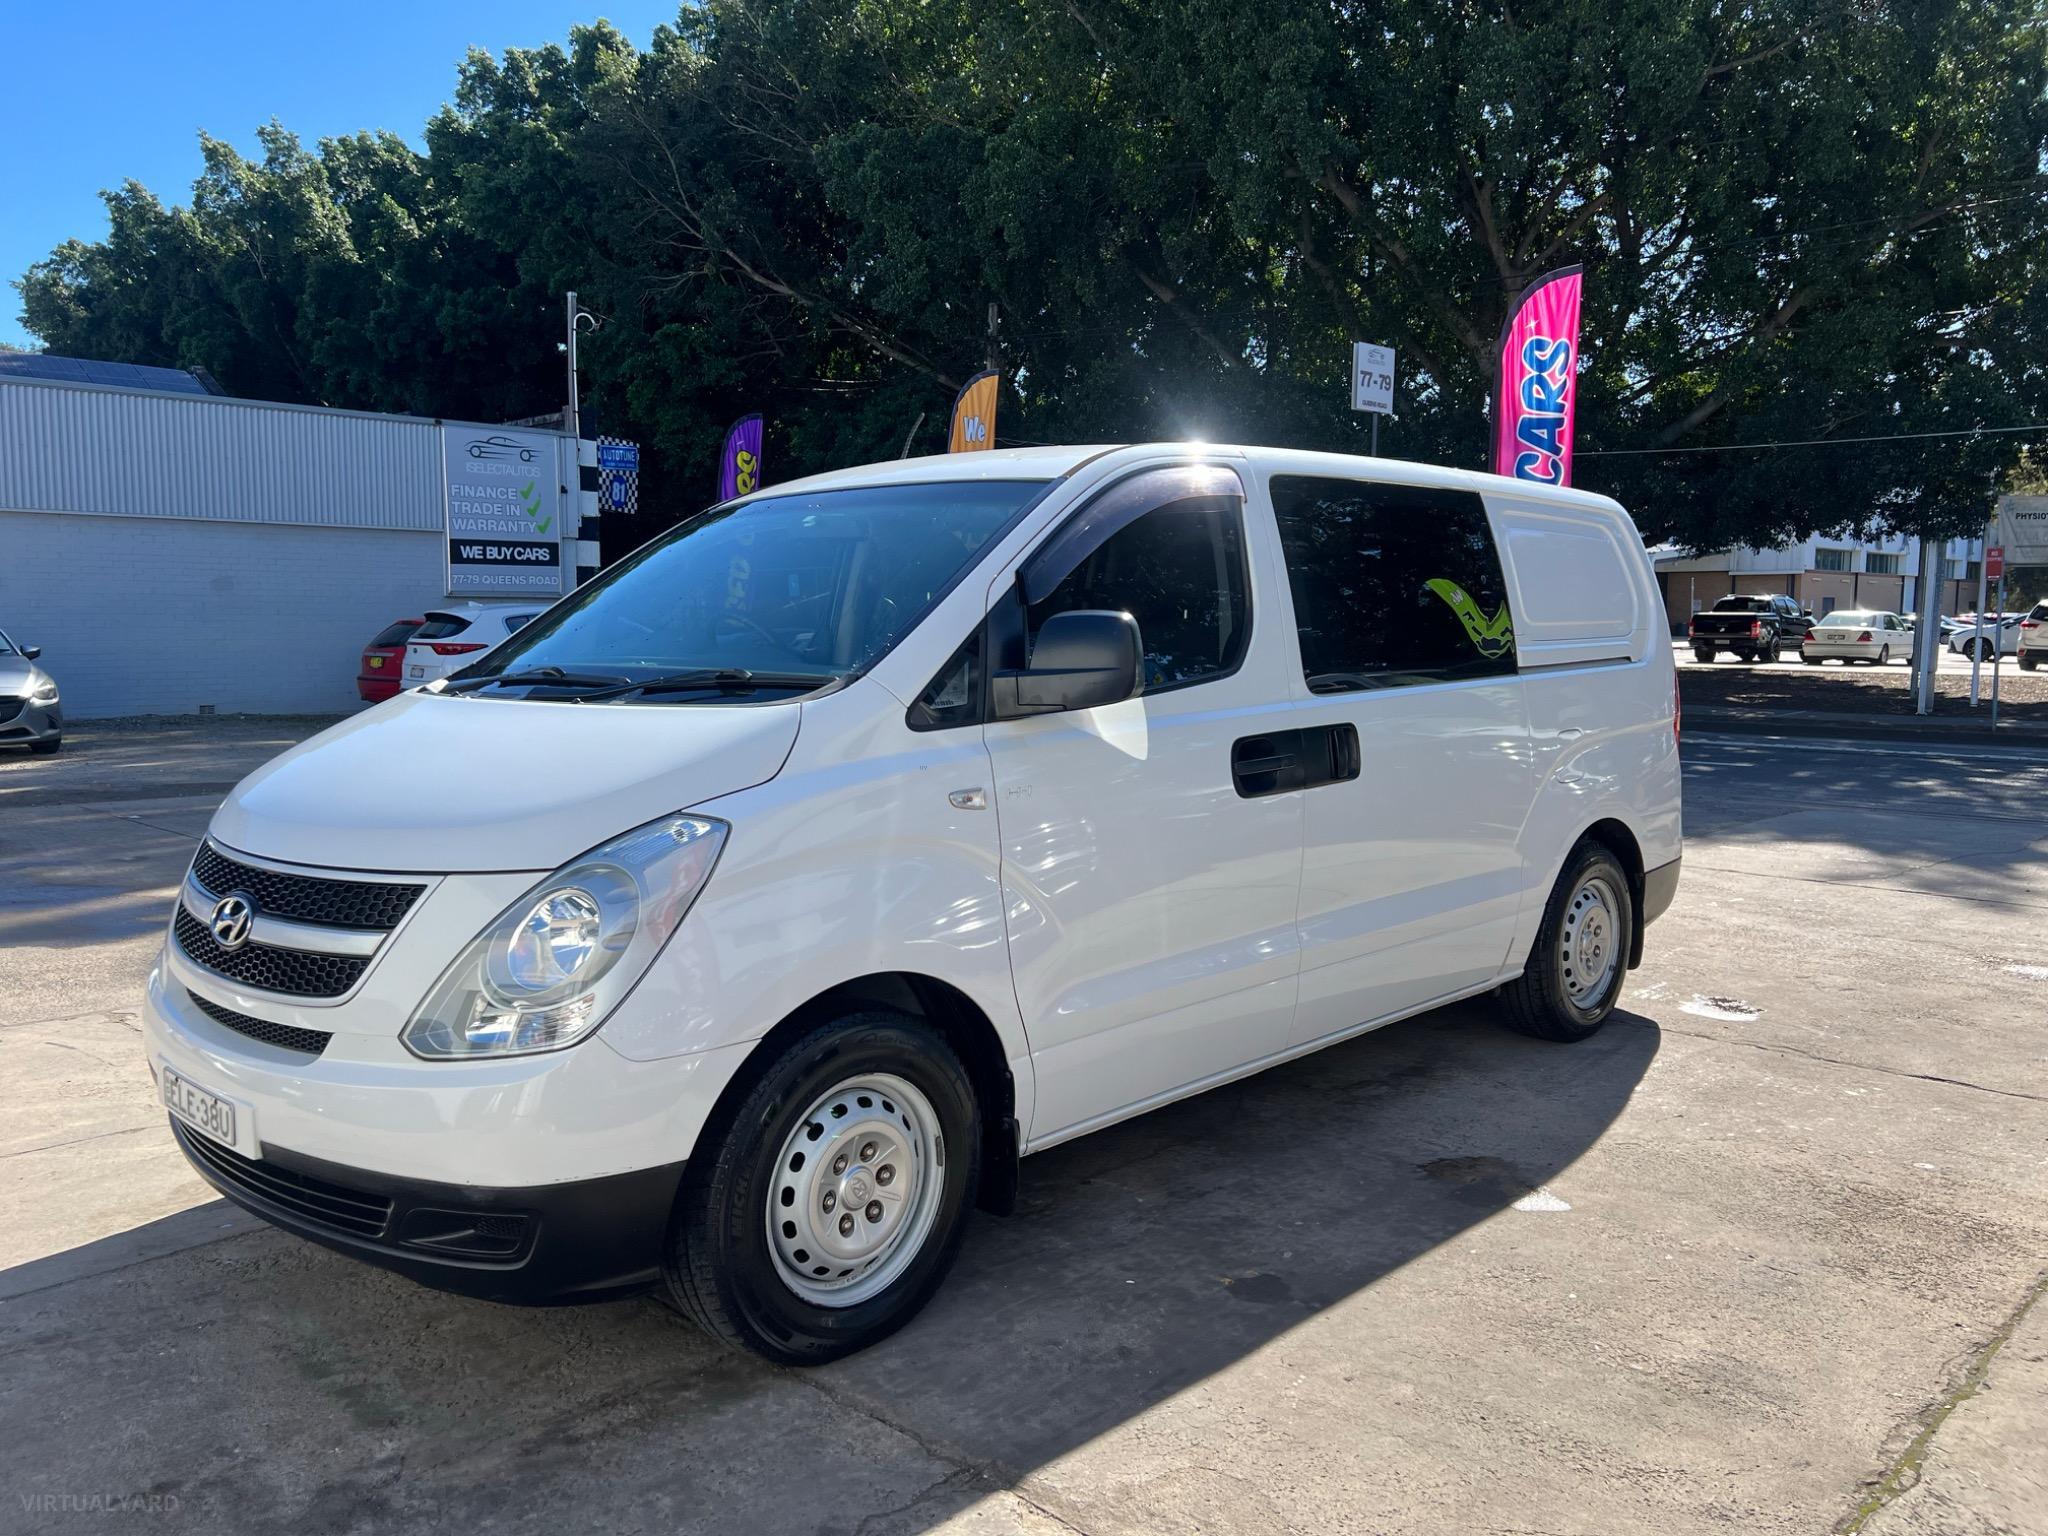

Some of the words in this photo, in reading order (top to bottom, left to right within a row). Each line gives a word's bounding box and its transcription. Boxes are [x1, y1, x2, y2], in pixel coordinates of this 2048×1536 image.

[1514, 335, 1573, 487] CARS
[963, 415, 986, 444] We
[603, 449, 636, 462] AUTOTUNE
[451, 484, 518, 500] FINANCE
[612, 482, 626, 502] 81
[452, 501, 503, 515] TRADE
[506, 503, 521, 516] IN
[452, 518, 537, 533] WARRANTY
[460, 545, 484, 559] WE
[486, 546, 514, 560] BUY
[514, 547, 550, 561] CARS
[452, 574, 480, 585] 77-79
[482, 575, 527, 585] QUEENS
[528, 576, 559, 585] ROAD
